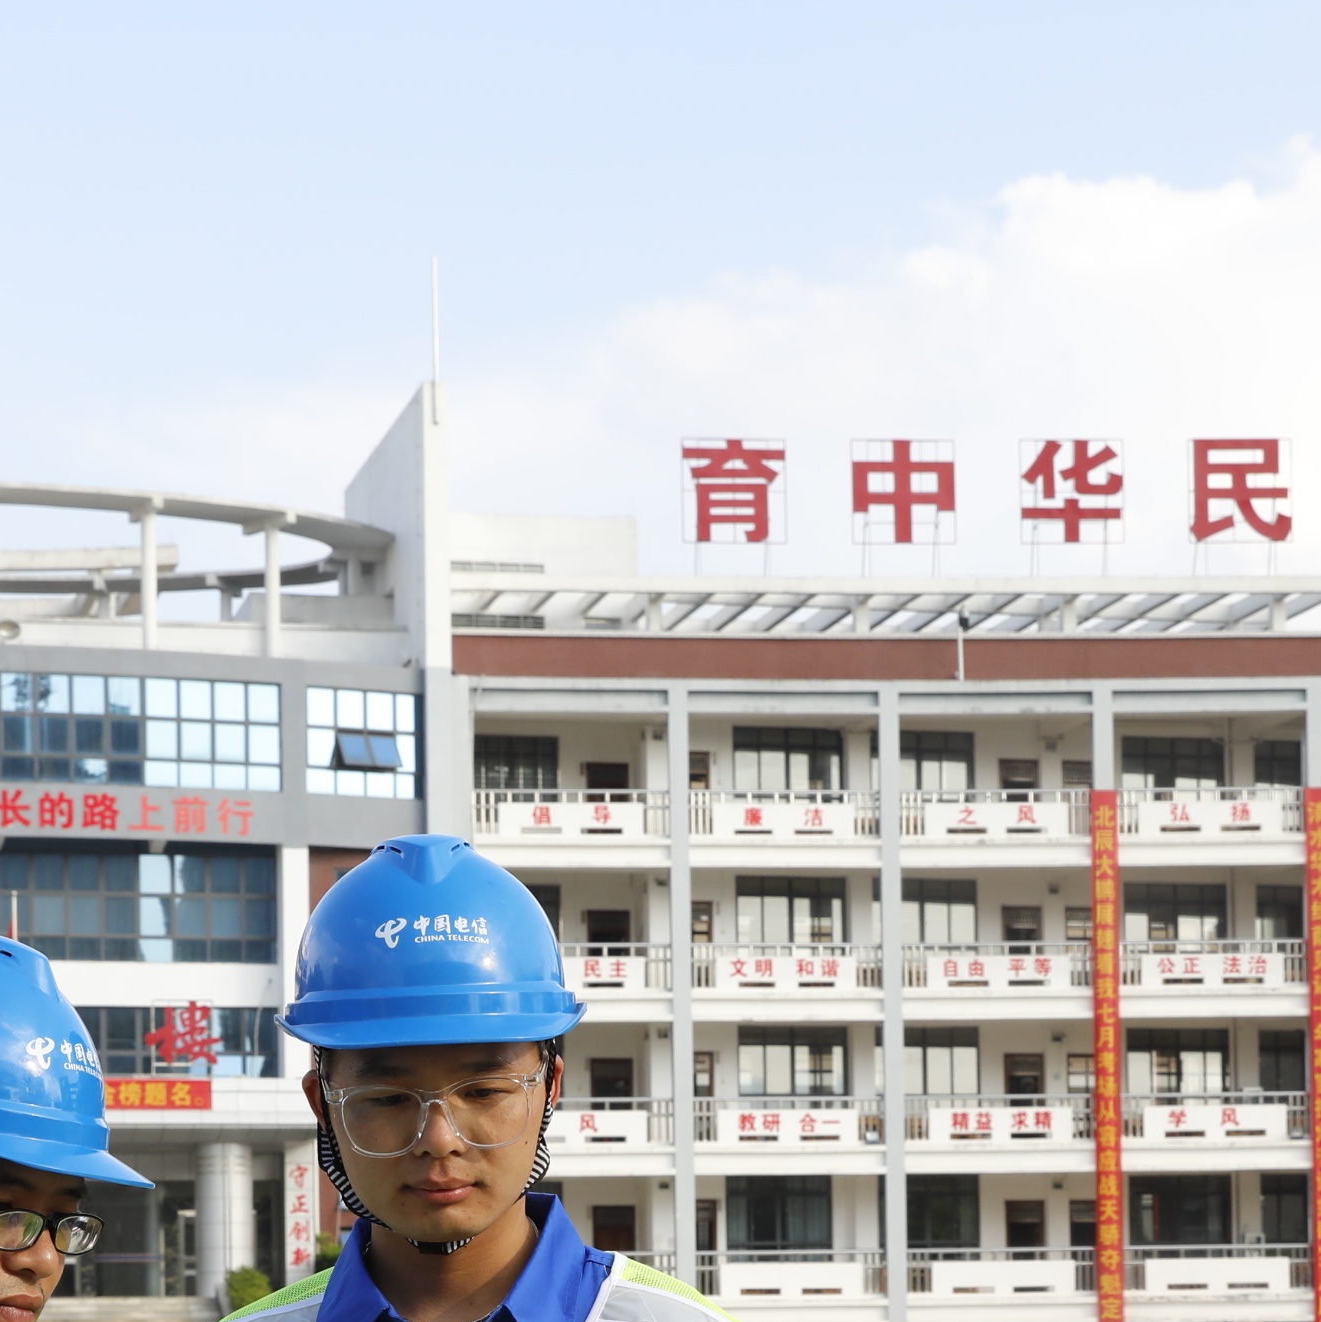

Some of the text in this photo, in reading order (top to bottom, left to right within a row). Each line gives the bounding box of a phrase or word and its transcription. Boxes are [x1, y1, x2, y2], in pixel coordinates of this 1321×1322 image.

[413, 914, 488, 936] 中国电信
[414, 934, 490, 945] CHINA TELECOM
[583, 957, 625, 979] 民主
[60, 1039, 100, 1069] 中国电
